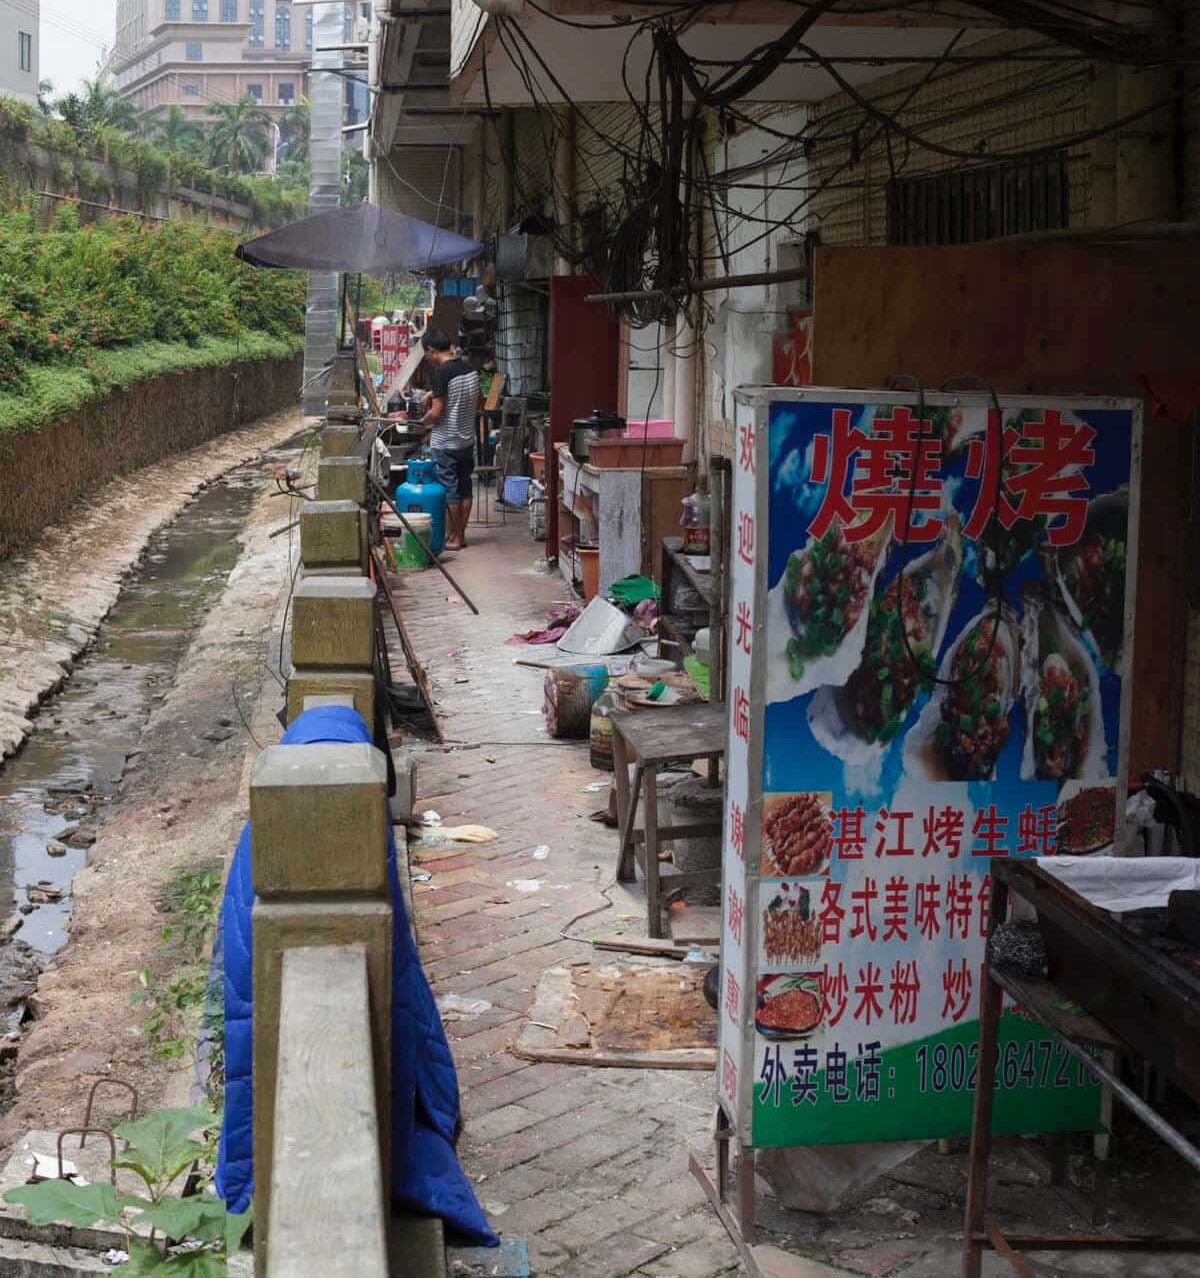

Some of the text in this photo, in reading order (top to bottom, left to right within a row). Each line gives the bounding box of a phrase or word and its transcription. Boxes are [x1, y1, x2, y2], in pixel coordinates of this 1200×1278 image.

[827, 803, 1058, 860] 湛江烤生蚝
